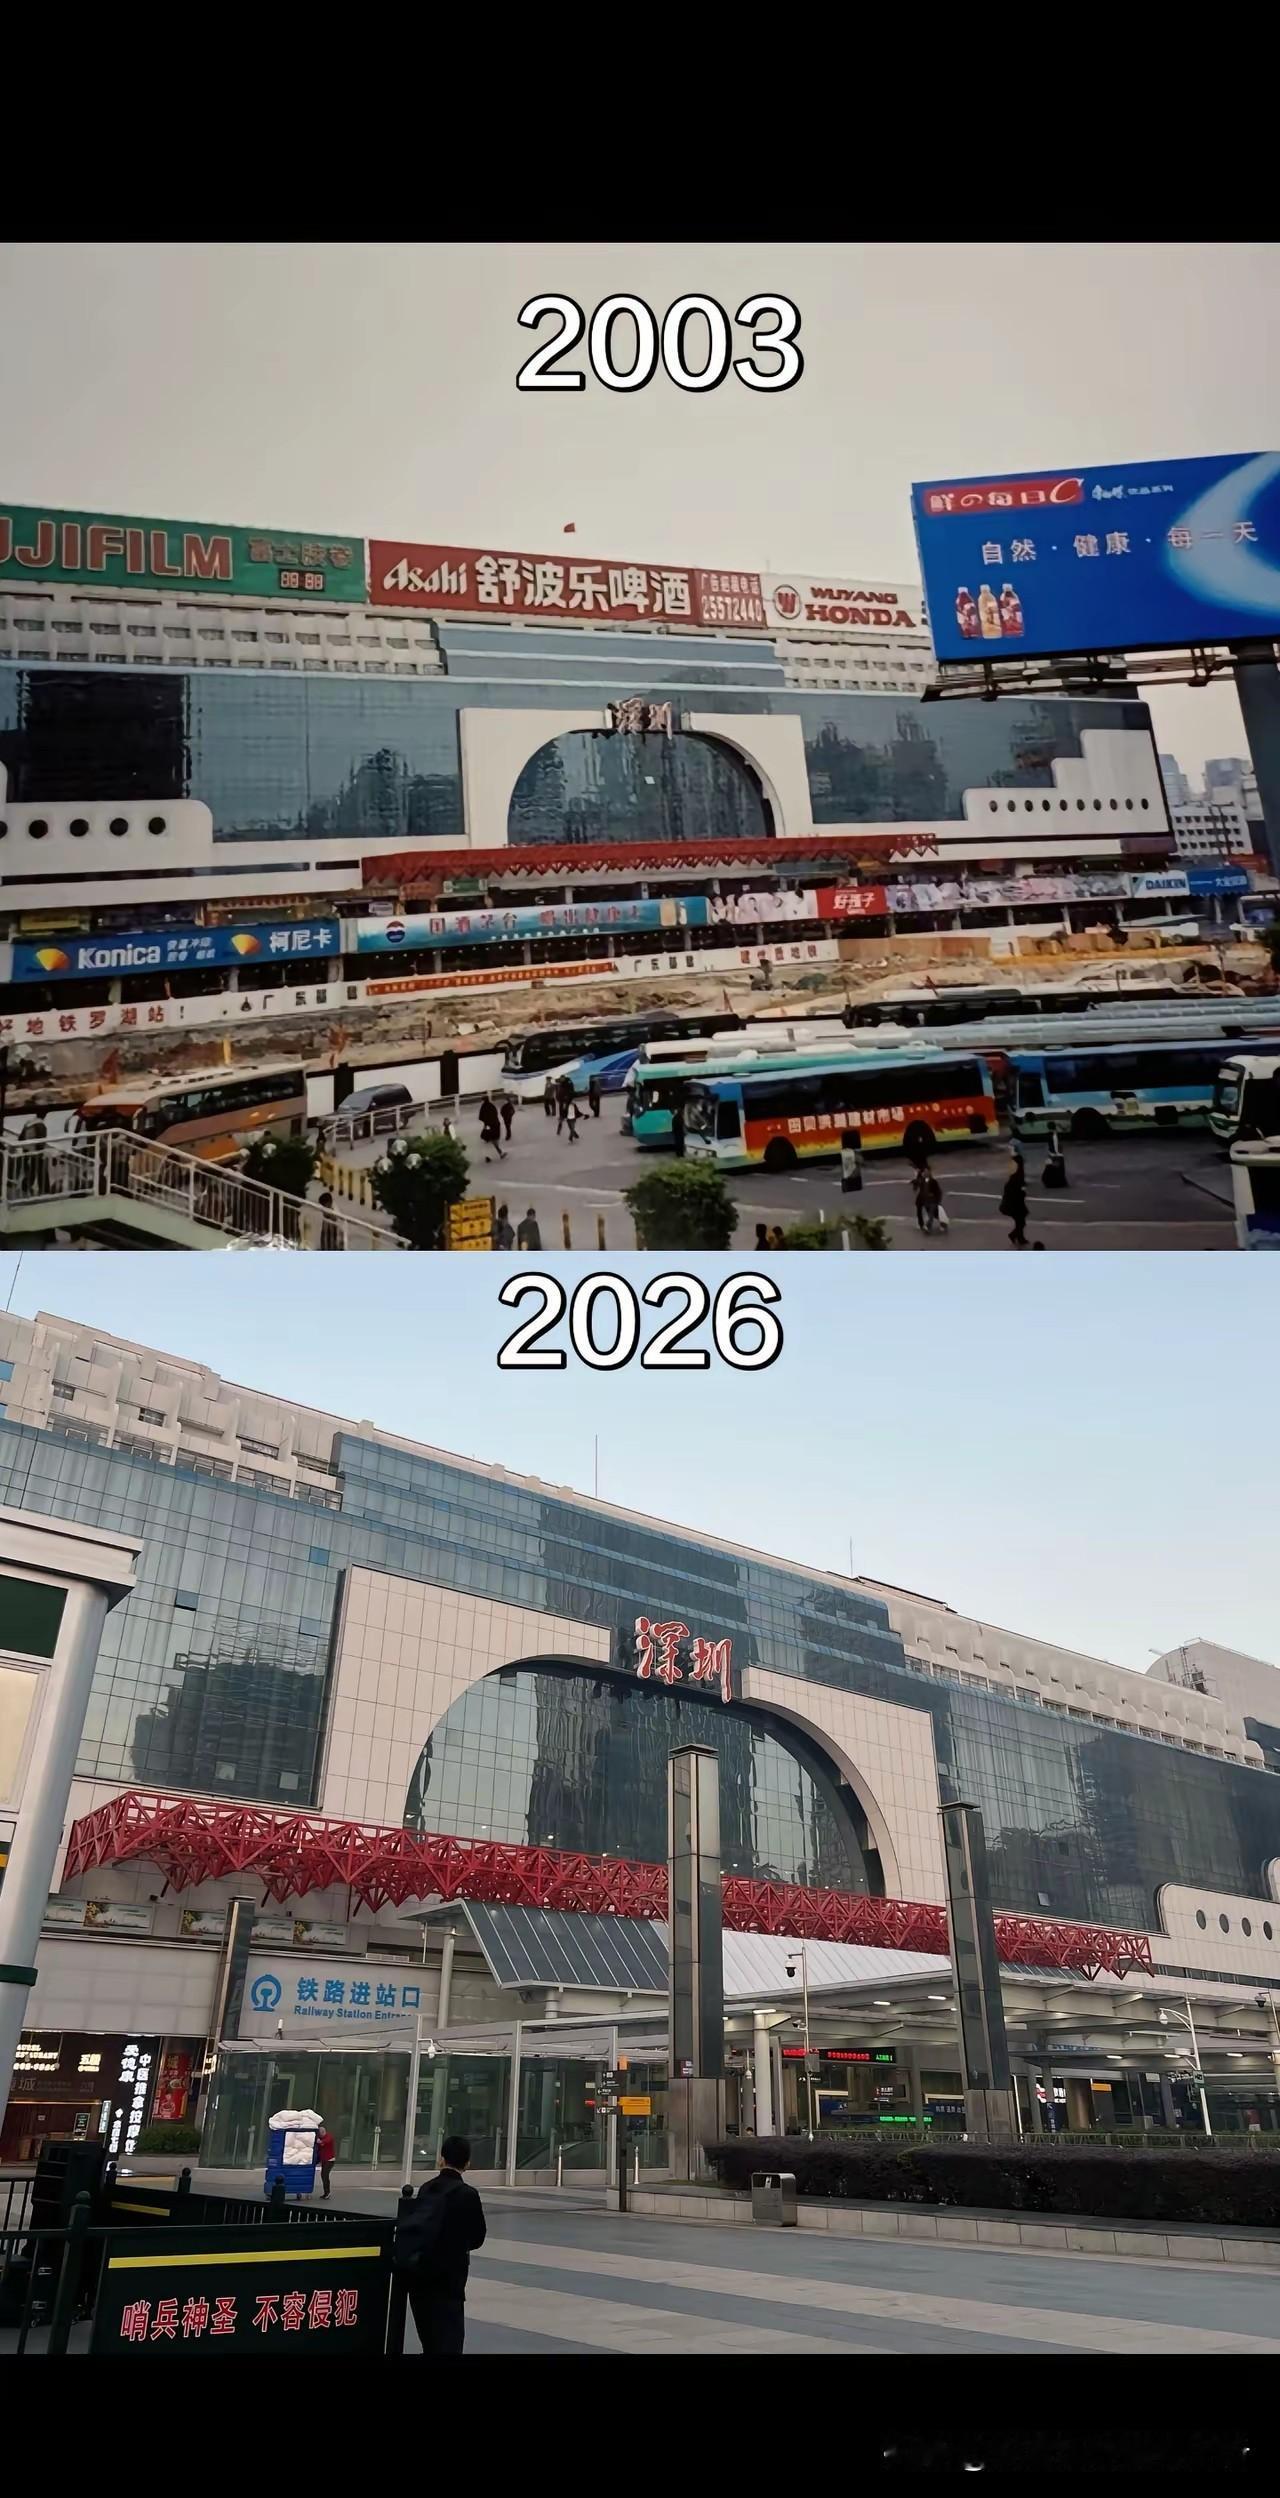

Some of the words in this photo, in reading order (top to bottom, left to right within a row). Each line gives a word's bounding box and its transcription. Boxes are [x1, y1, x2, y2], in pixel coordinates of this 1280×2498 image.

[383, 558, 467, 594] Asahi
[475, 555, 691, 615] 舒波乐啤酒
[810, 587, 898, 604] WUYANG
[701, 596, 763, 622] 25572440
[805, 604, 916, 627] HONDA
[1145, 879, 1186, 890] DAIKIN
[269, 927, 333, 953] 柯尼卡
[78, 944, 160, 969] Konica
[635, 1617, 732, 1704] 深圳
[296, 1977, 421, 2009] 铁路进站口
[294, 2005, 333, 2020] Railway
[336, 2009, 373, 2020] Station
[375, 2010, 413, 2020] Entr
[120, 2297, 238, 2342] 哨兵神圣
[252, 2288, 358, 2332] 不容侵犯
